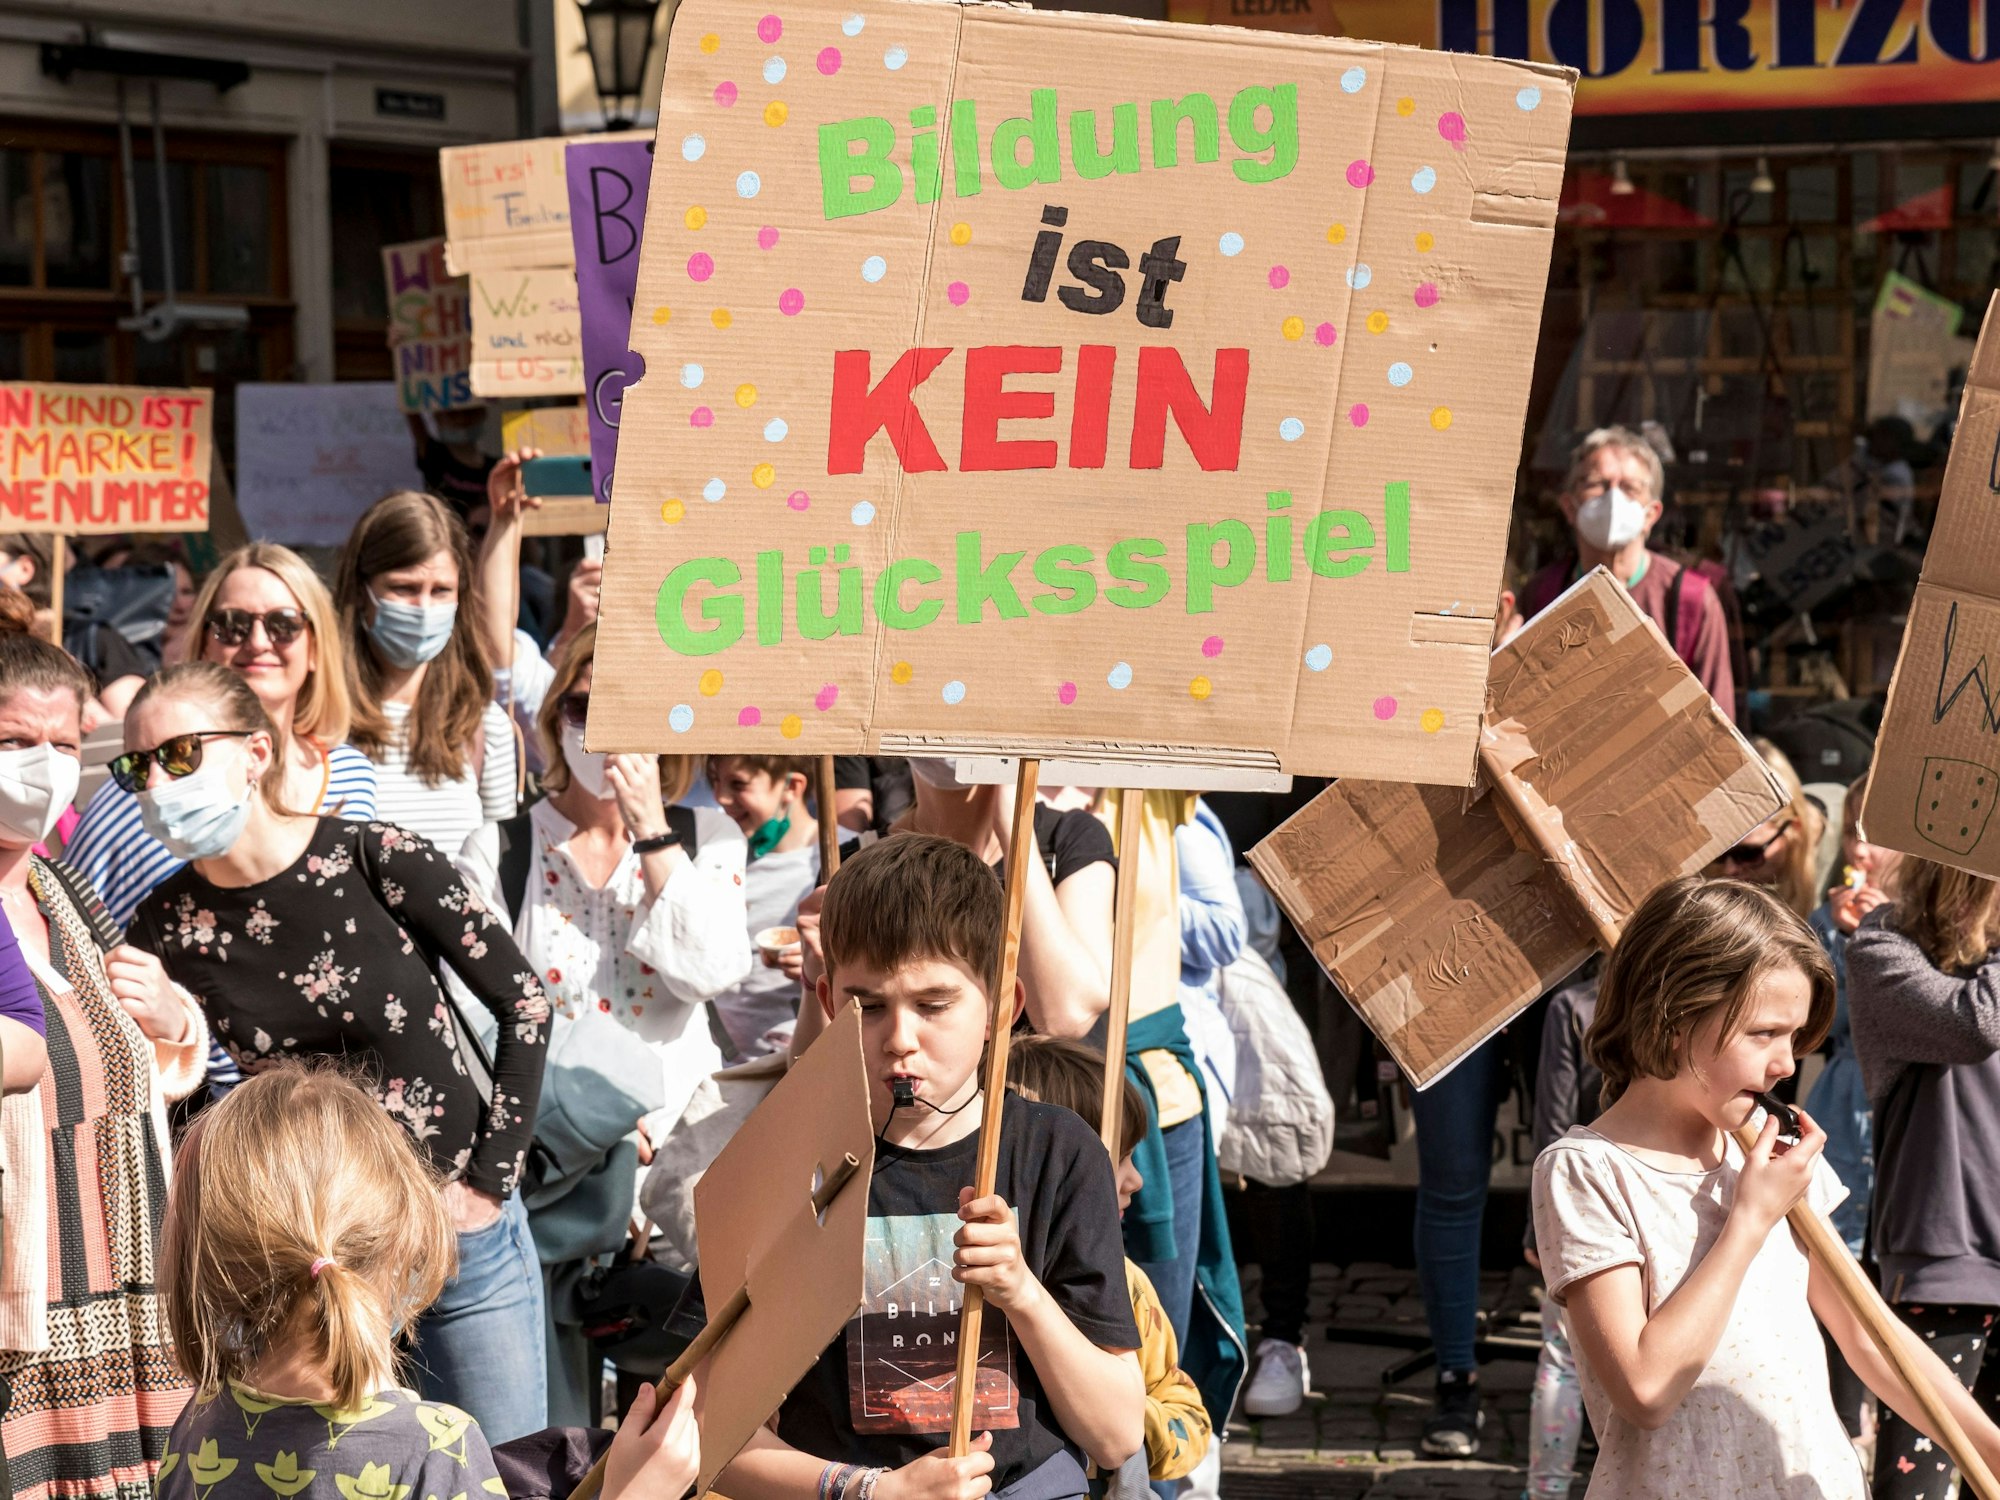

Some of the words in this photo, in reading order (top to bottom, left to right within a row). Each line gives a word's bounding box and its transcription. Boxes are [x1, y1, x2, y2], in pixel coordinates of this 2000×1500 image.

[819, 84, 1298, 218] Bildung
[589, 166, 637, 265] B
[1022, 205, 1186, 328] ist
[0, 388, 33, 429] N
[38, 393, 134, 428] KIND
[142, 396, 204, 430] IST
[828, 345, 1249, 475] KEIN
[53, 480, 209, 524] NUMMER
[656, 482, 1409, 655] Glücksspiel
[887, 1300, 959, 1319] BILL
